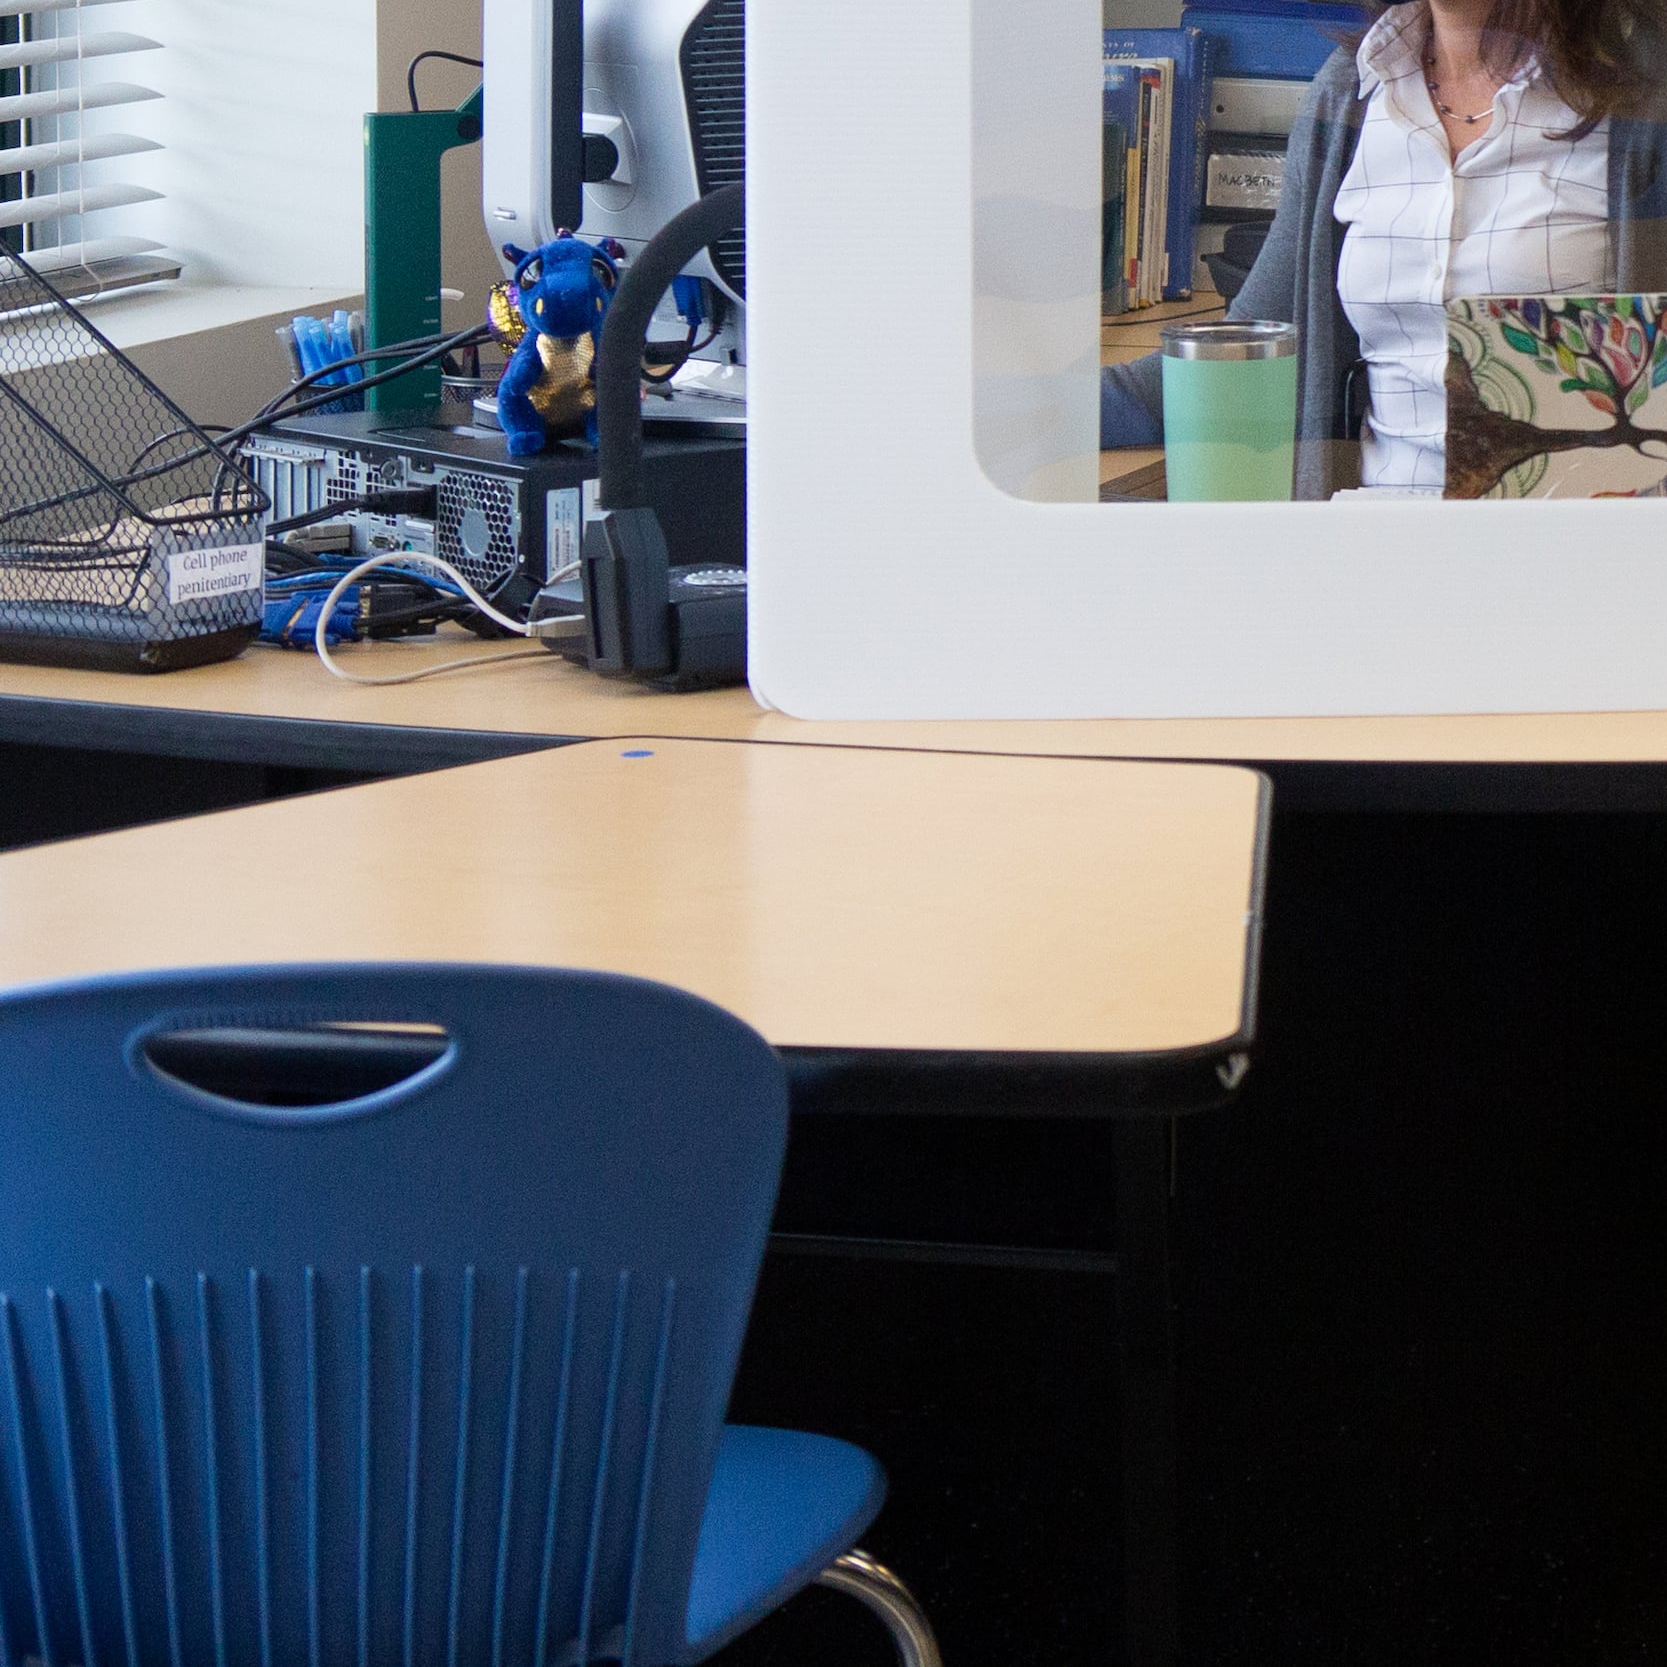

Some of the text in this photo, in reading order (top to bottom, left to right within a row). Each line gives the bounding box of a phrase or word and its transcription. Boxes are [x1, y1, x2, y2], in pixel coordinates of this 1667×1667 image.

[183, 549, 248, 571] Cell phone
[177, 572, 251, 600] penitentiary
